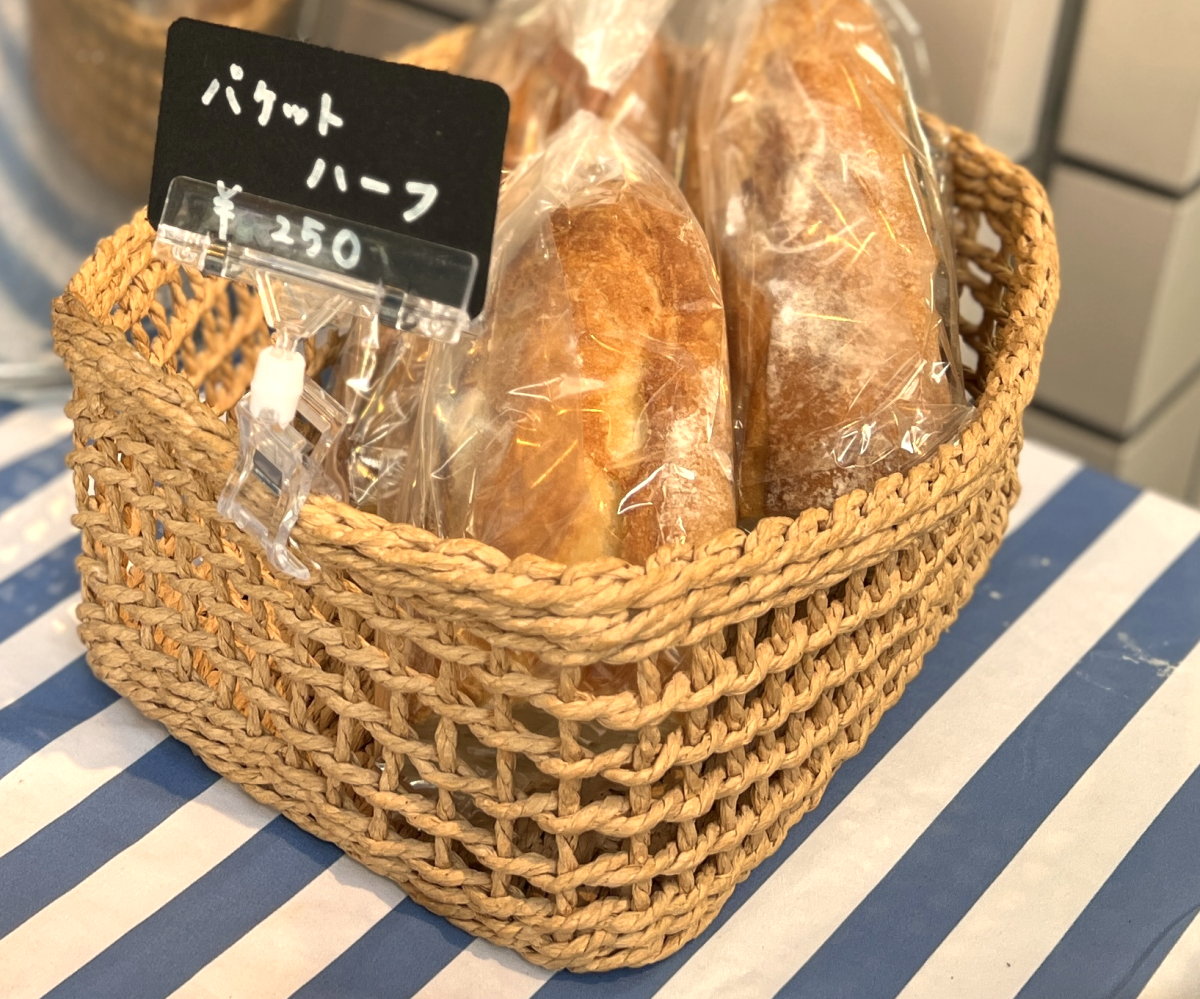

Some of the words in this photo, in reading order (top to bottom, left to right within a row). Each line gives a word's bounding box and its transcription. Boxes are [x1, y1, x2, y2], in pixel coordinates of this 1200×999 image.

[306, 158, 439, 222] ハーフ
[270, 213, 361, 270] 250
